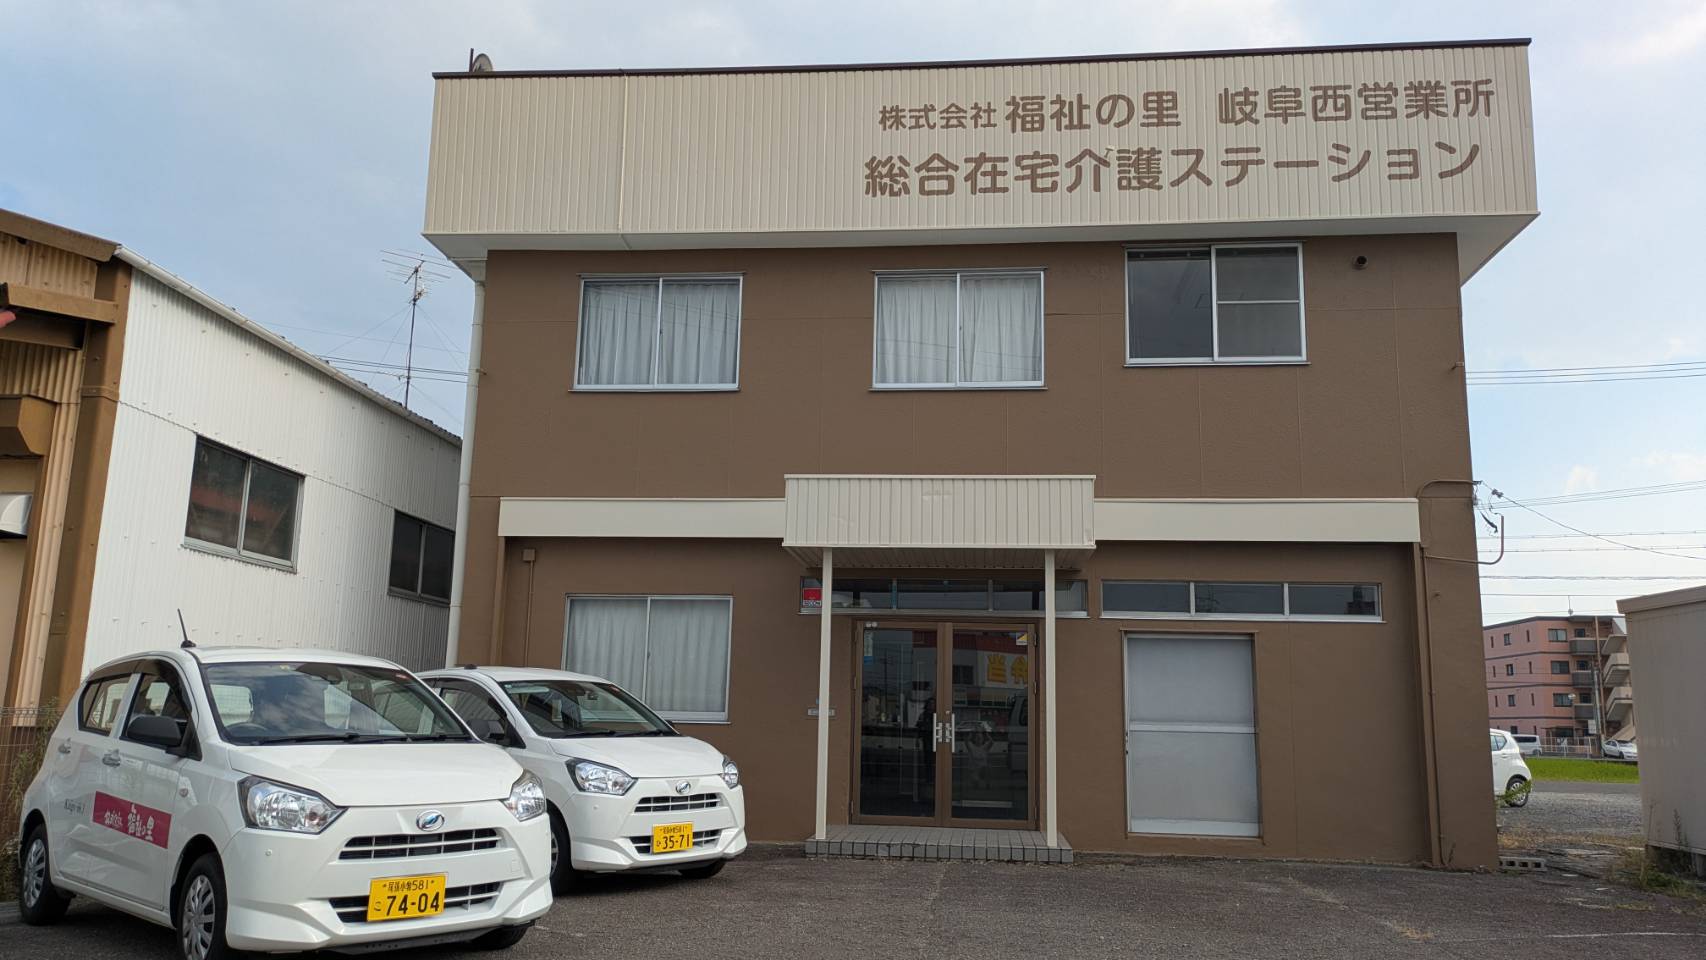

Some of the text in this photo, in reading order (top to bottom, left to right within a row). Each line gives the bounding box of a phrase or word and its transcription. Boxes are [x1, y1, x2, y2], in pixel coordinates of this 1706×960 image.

[1217, 78, 1494, 126] 岐阜西営業所
[864, 140, 1481, 198] 総合在宅介護ステーション
[662, 833, 690, 850] 35-71
[386, 891, 440, 916] 74-04
